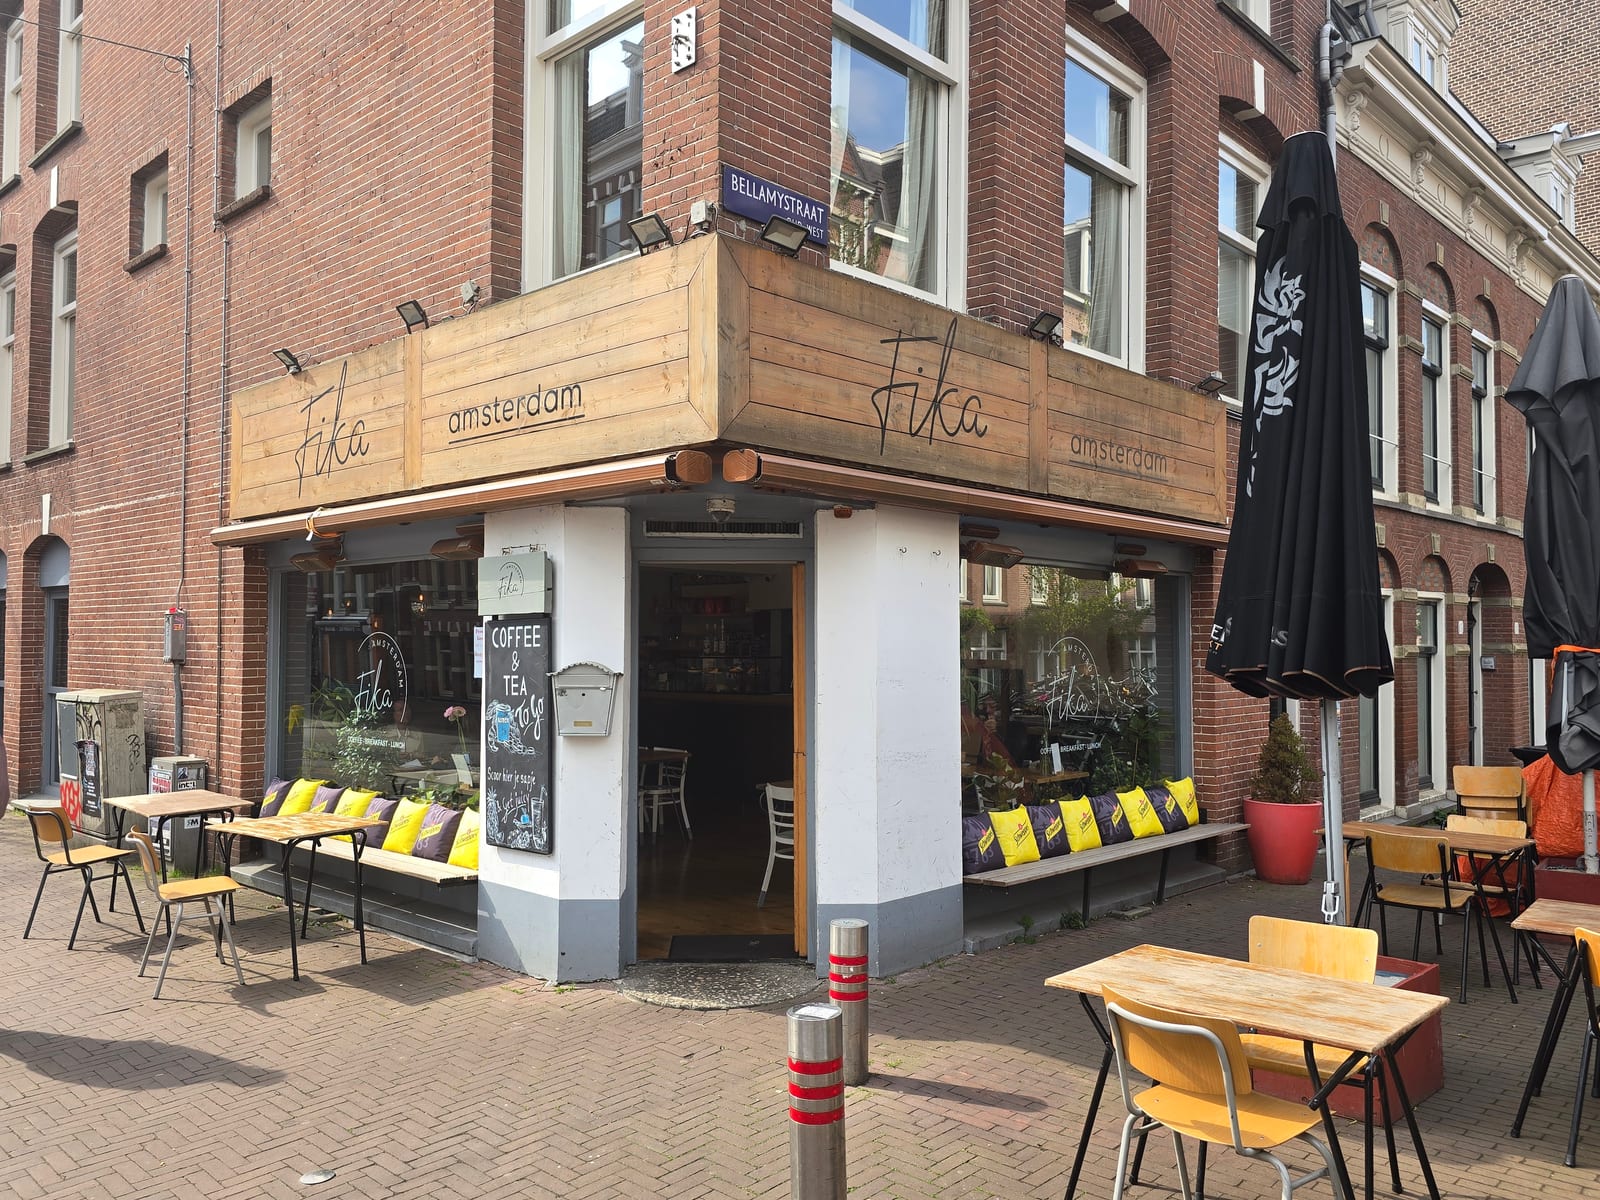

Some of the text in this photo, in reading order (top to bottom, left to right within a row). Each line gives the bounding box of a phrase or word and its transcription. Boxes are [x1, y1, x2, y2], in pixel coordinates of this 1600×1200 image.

[731, 173, 824, 224] BELLAMYSTRAAT
[449, 384, 582, 434] amsterdam
[871, 317, 988, 456] Fika
[295, 360, 370, 499] Fika
[1070, 434, 1168, 474] amsterdam
[492, 625, 541, 648] COFFEE
[512, 650, 520, 671] &
[371, 639, 404, 688] AMSTERDAM
[503, 675, 528, 696] TEA
[354, 659, 393, 722] Fika
